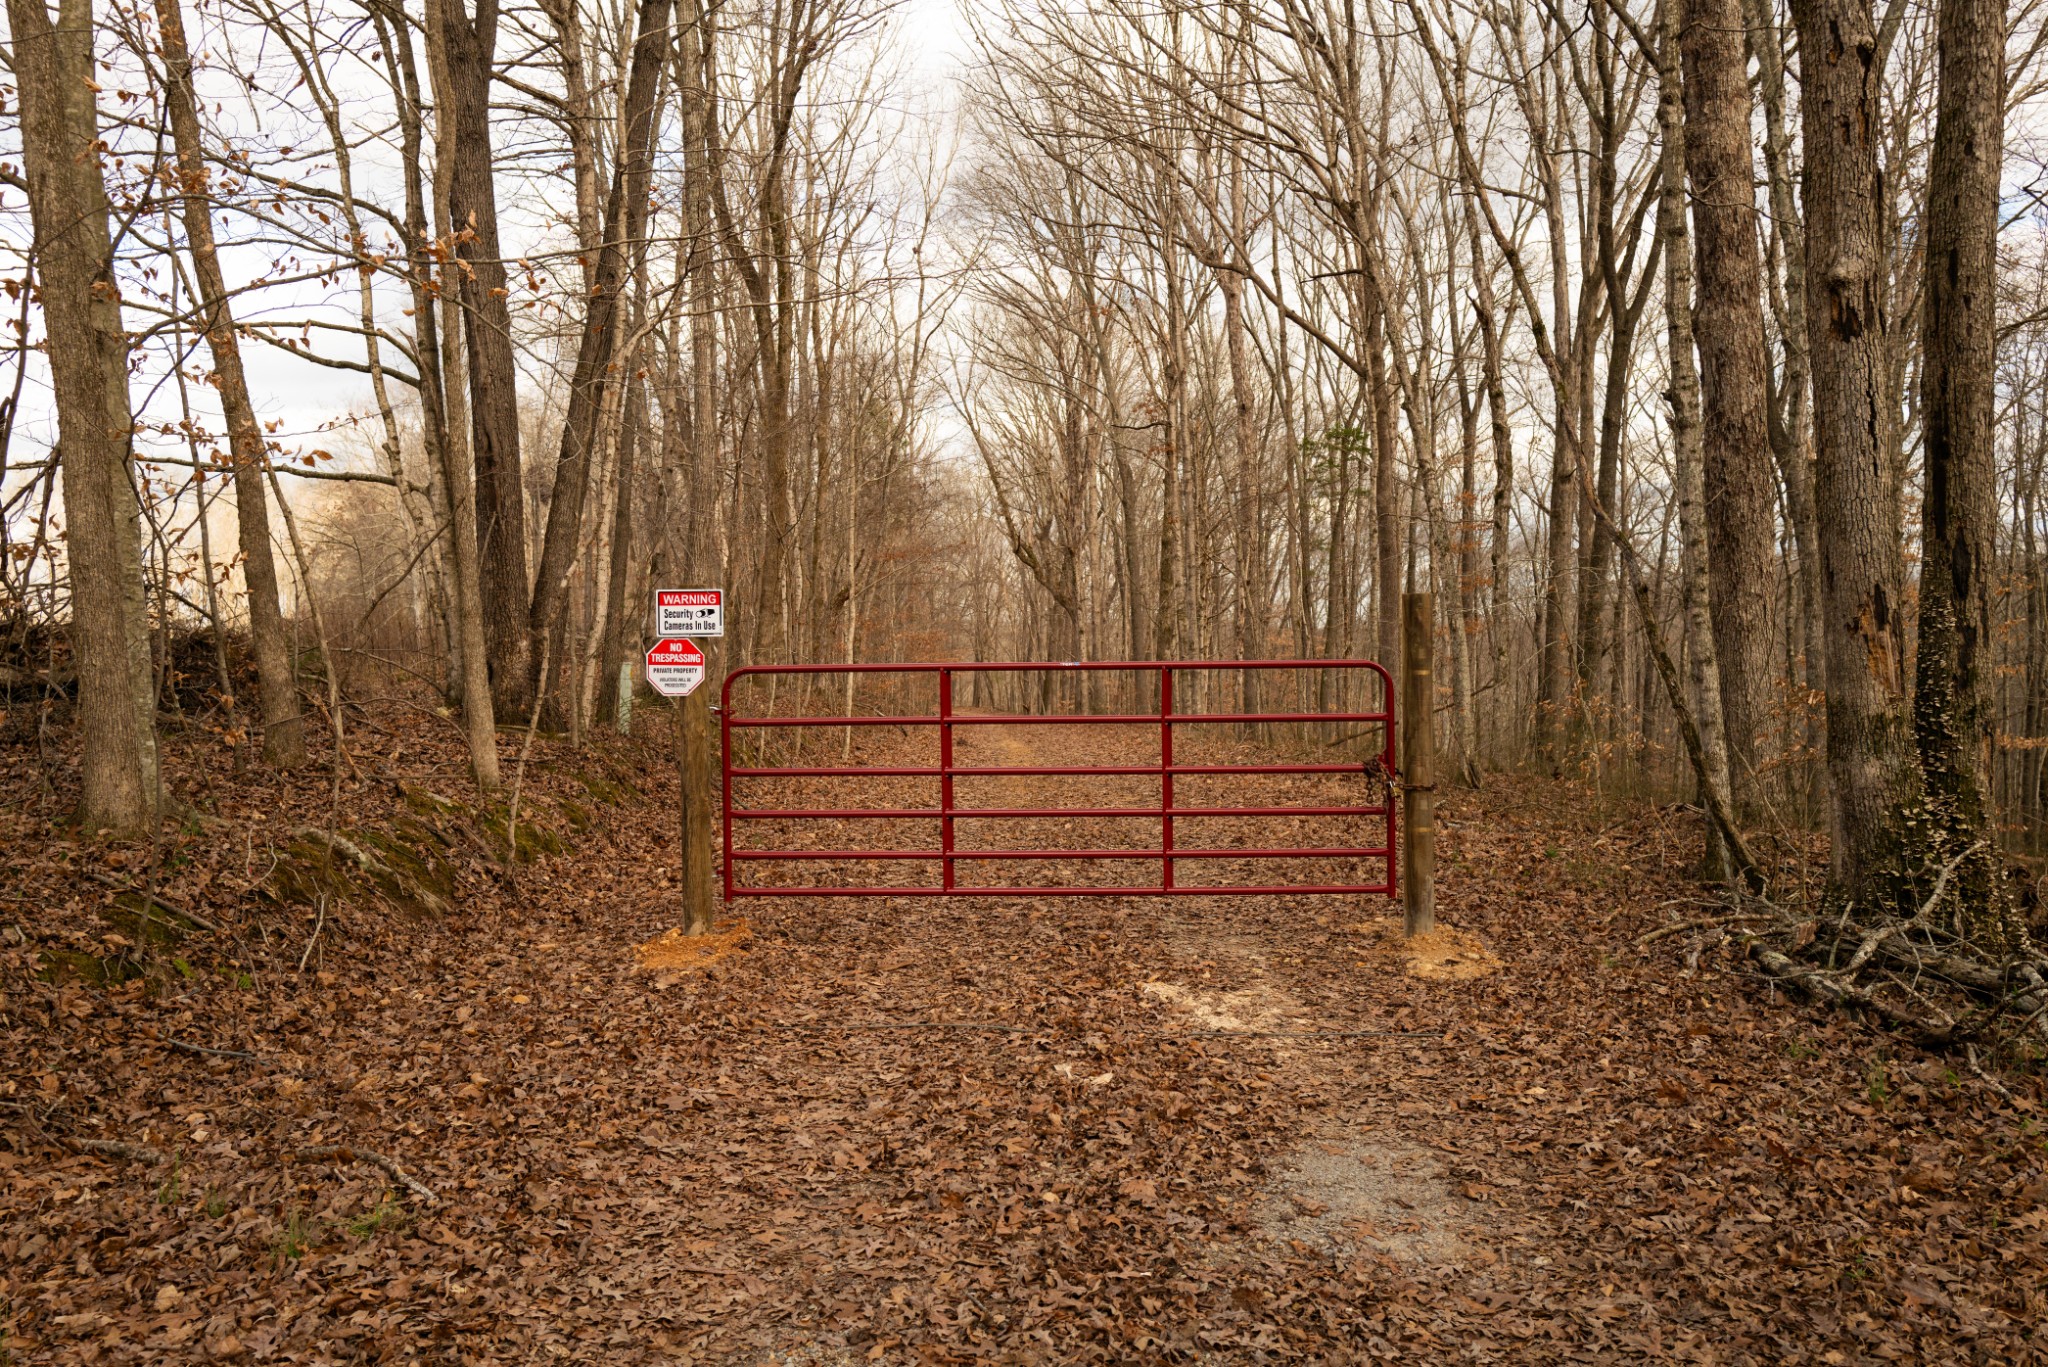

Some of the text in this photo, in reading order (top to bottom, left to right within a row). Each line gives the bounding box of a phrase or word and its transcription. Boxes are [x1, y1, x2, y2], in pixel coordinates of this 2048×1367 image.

[663, 594, 717, 604] WARNING
[664, 608, 694, 620] Security
[664, 621, 716, 630] Cameras In Use
[670, 643, 682, 652] NO
[651, 654, 701, 662] TRESPASSING
